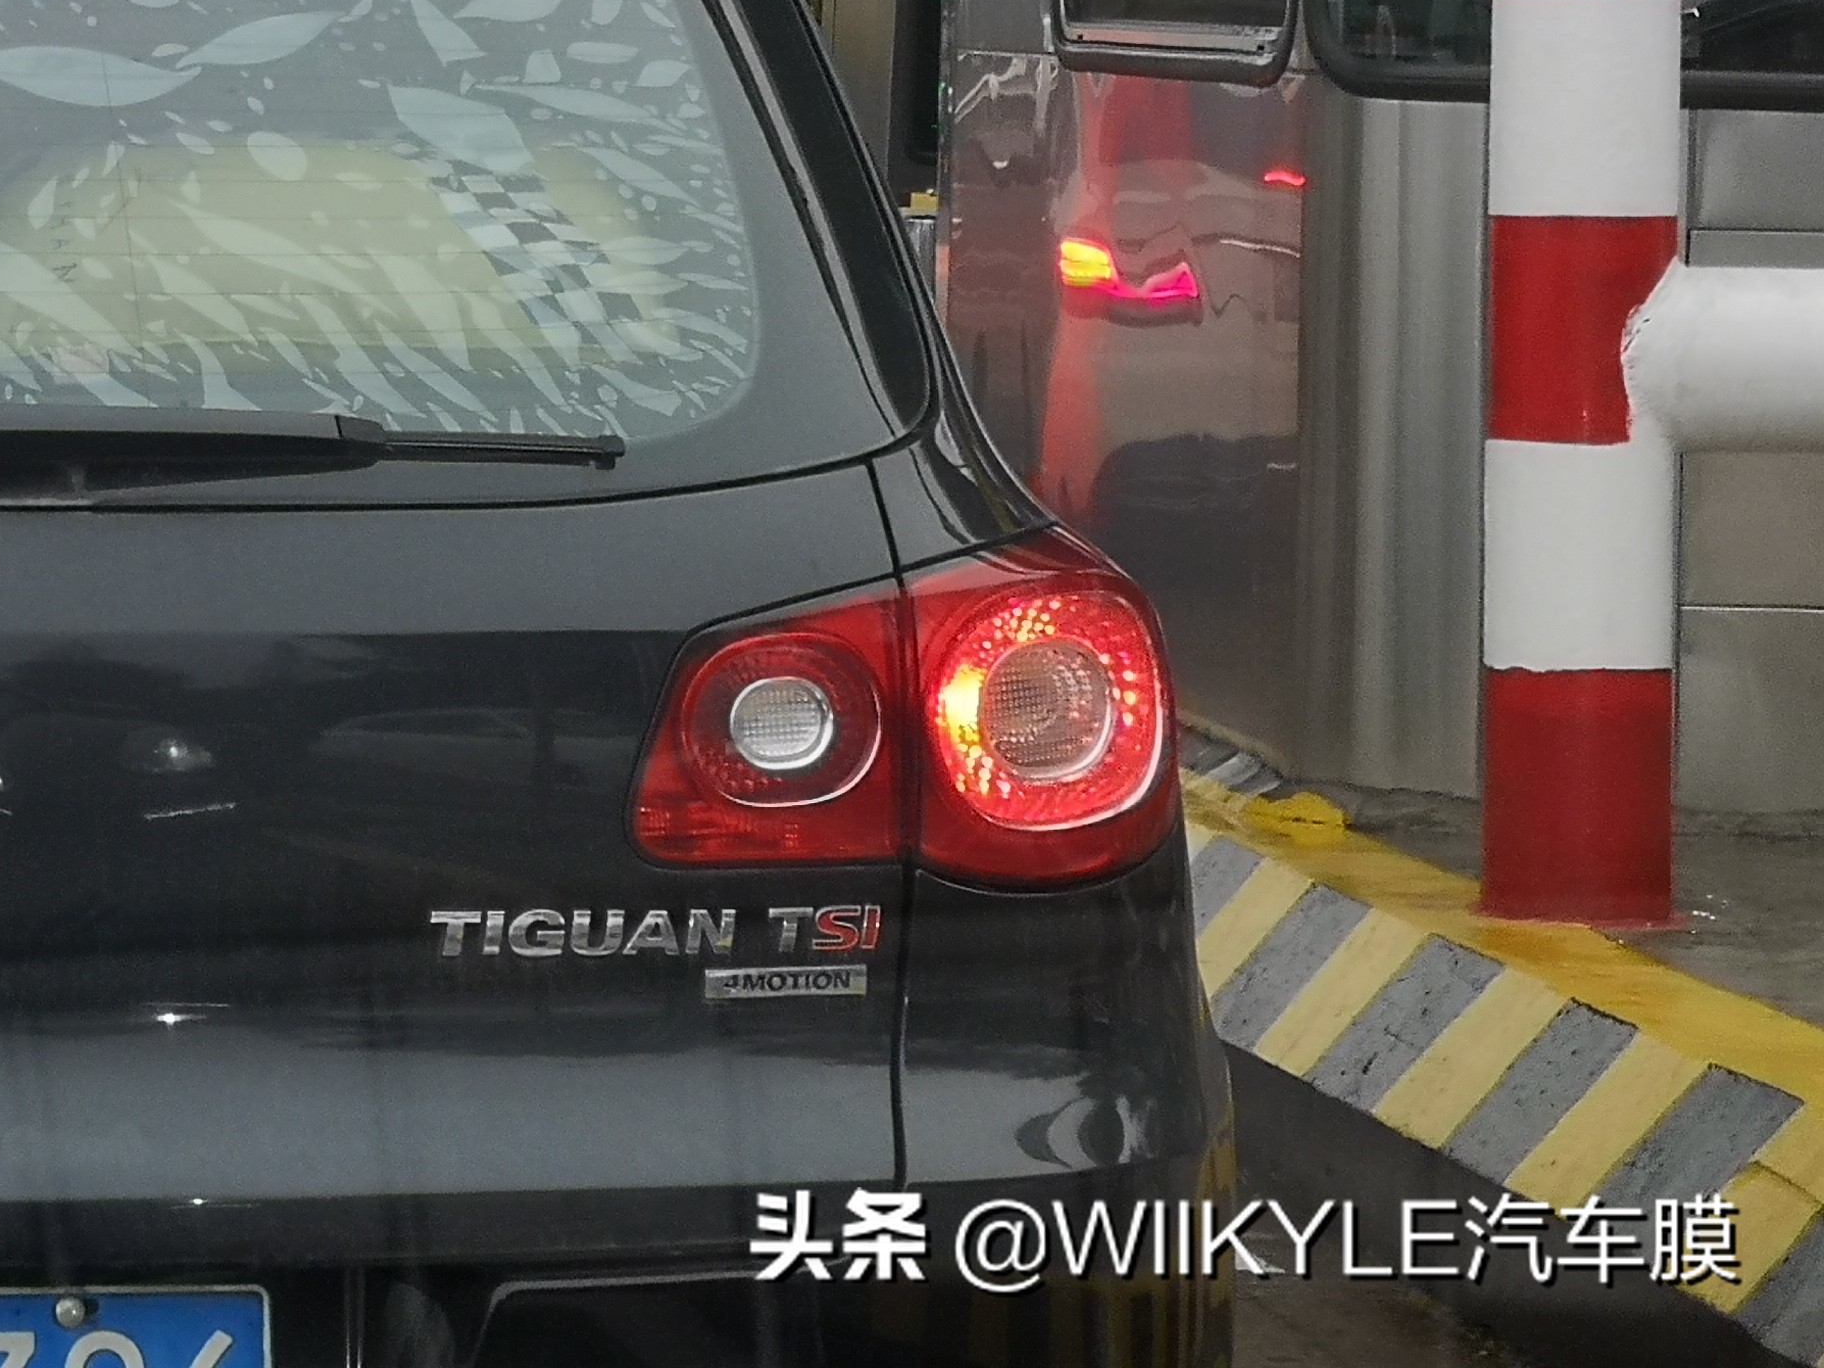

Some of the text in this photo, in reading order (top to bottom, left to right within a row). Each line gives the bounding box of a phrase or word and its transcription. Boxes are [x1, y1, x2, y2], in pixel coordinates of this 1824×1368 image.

[430, 904, 882, 958] TIGUAN TSI
[722, 968, 853, 993] 4MOTION
